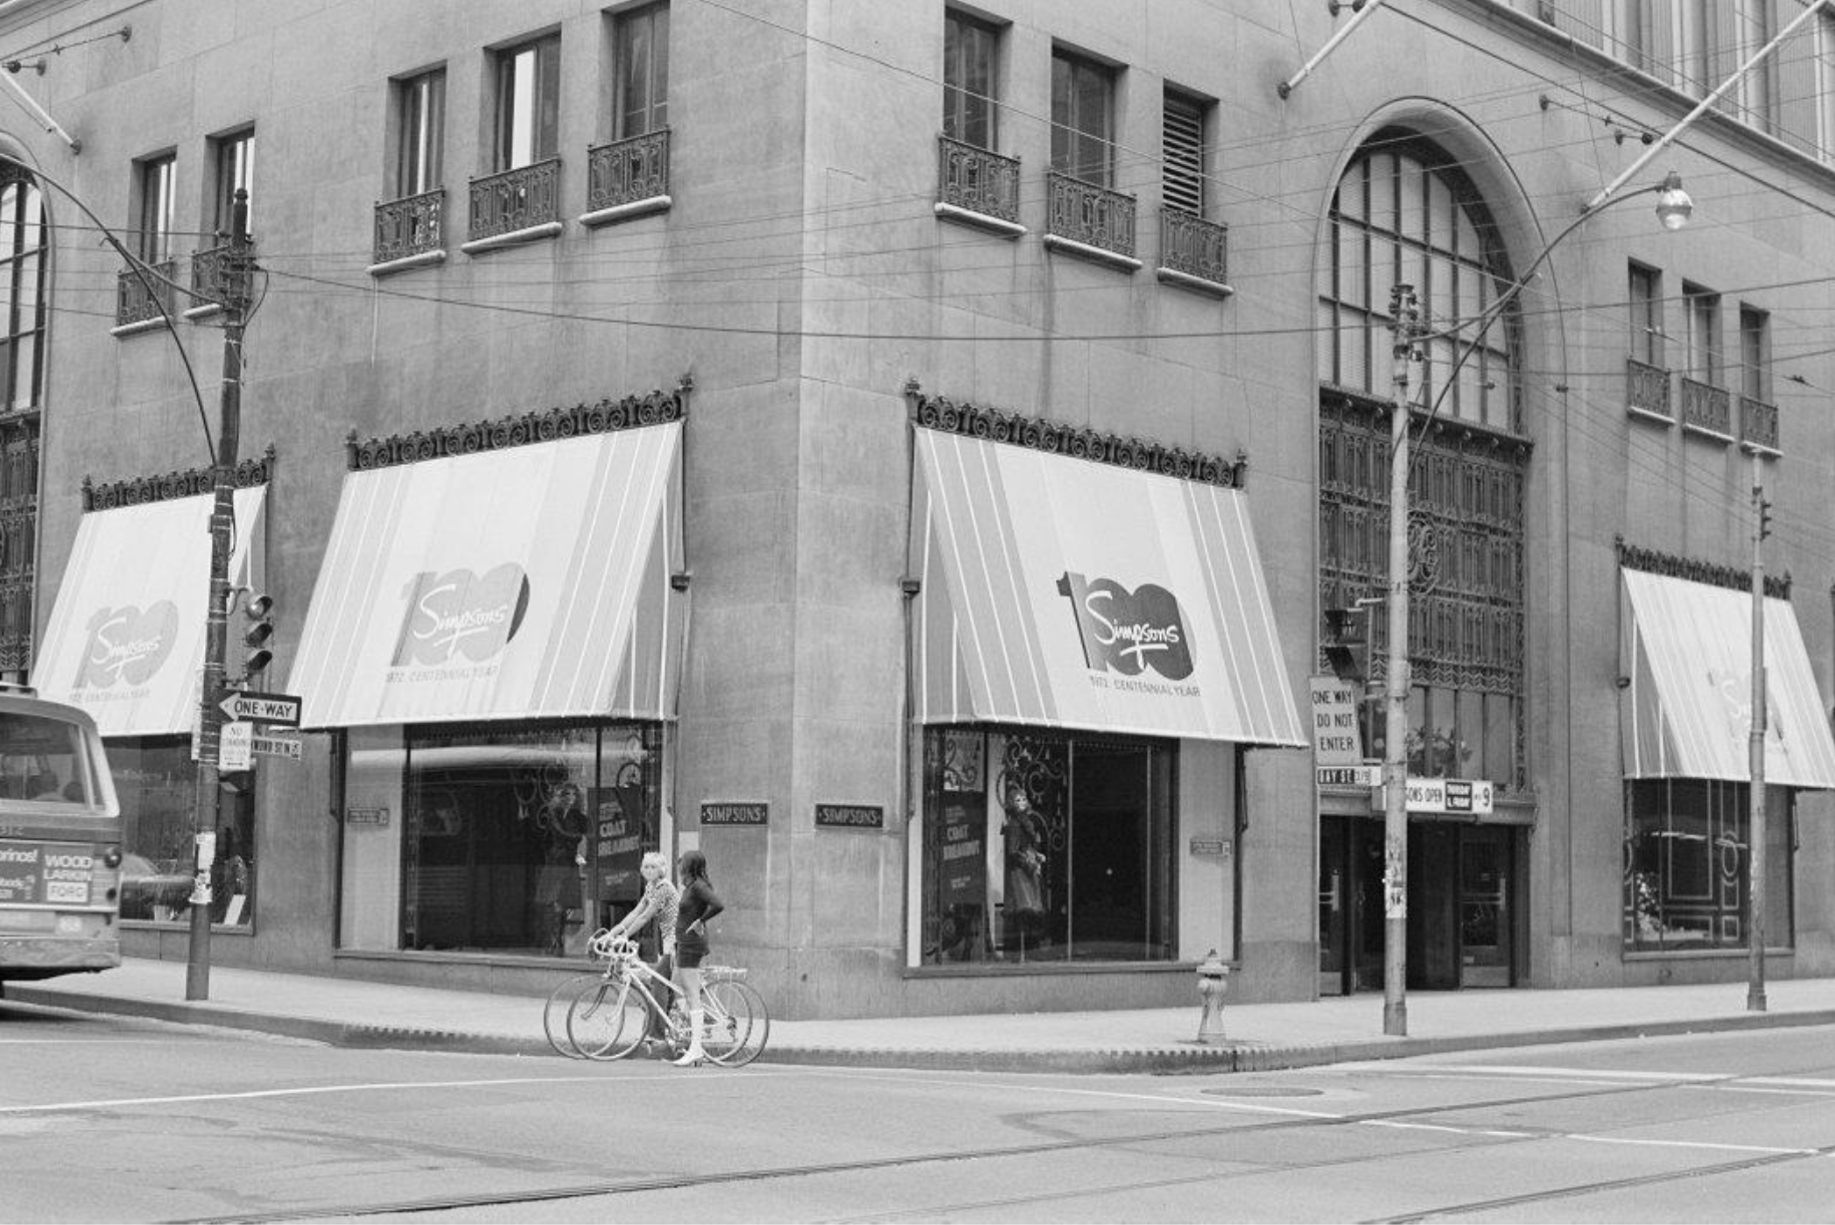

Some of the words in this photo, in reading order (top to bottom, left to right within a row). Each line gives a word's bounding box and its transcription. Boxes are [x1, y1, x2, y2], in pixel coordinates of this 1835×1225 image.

[413, 583, 508, 656] Simpsons
[1085, 590, 1179, 670] Simpsons
[90, 616, 161, 679] Simpsons
[1113, 679, 1171, 694] CENTENNIAL
[1171, 686, 1200, 697] YEAR
[1312, 691, 1331, 704] ONE
[1333, 691, 1352, 704] WAY
[1317, 713, 1330, 728] DO
[1334, 713, 1353, 727] NOT
[1320, 737, 1354, 750] ENTER
[1425, 787, 1443, 803] OPEN
[1482, 786, 1491, 807] 9
[706, 806, 761, 821] SIMPSONS
[822, 807, 878, 824] SIMPSONS
[44, 855, 93, 868] WOOD
